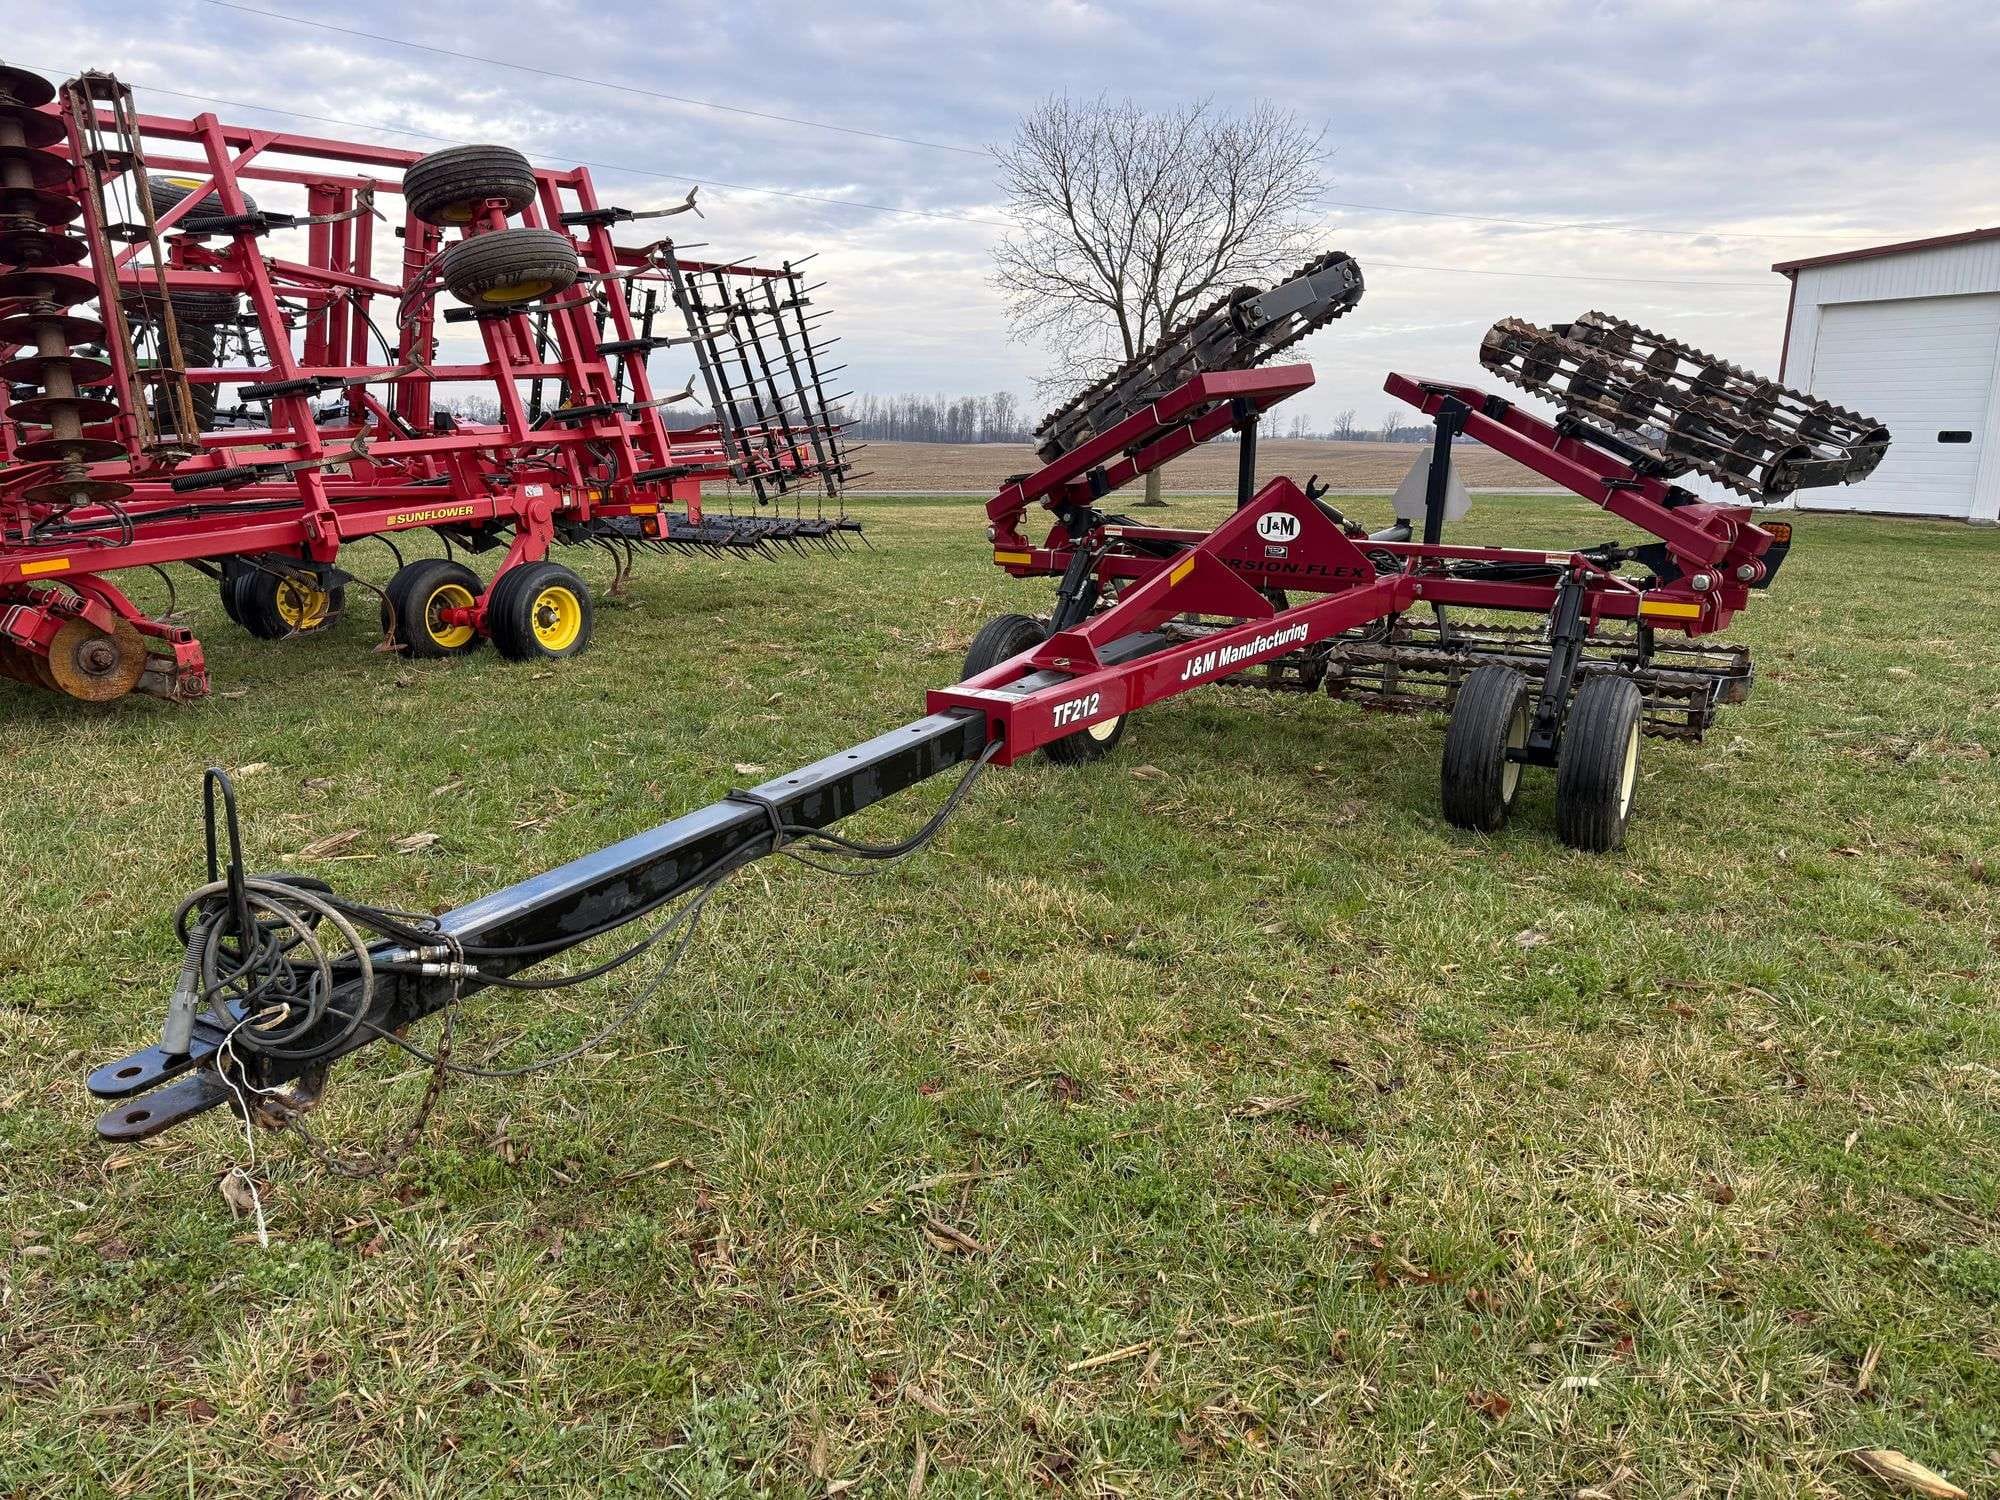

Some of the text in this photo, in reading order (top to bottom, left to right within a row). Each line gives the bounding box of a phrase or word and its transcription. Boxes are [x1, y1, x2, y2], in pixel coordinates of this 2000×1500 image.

[397, 505, 474, 524] SUNFLOWER
[1260, 516, 1295, 536] J&M
[1181, 623, 1309, 681] J&M Manufacturing
[1053, 692, 1100, 728] TF212
